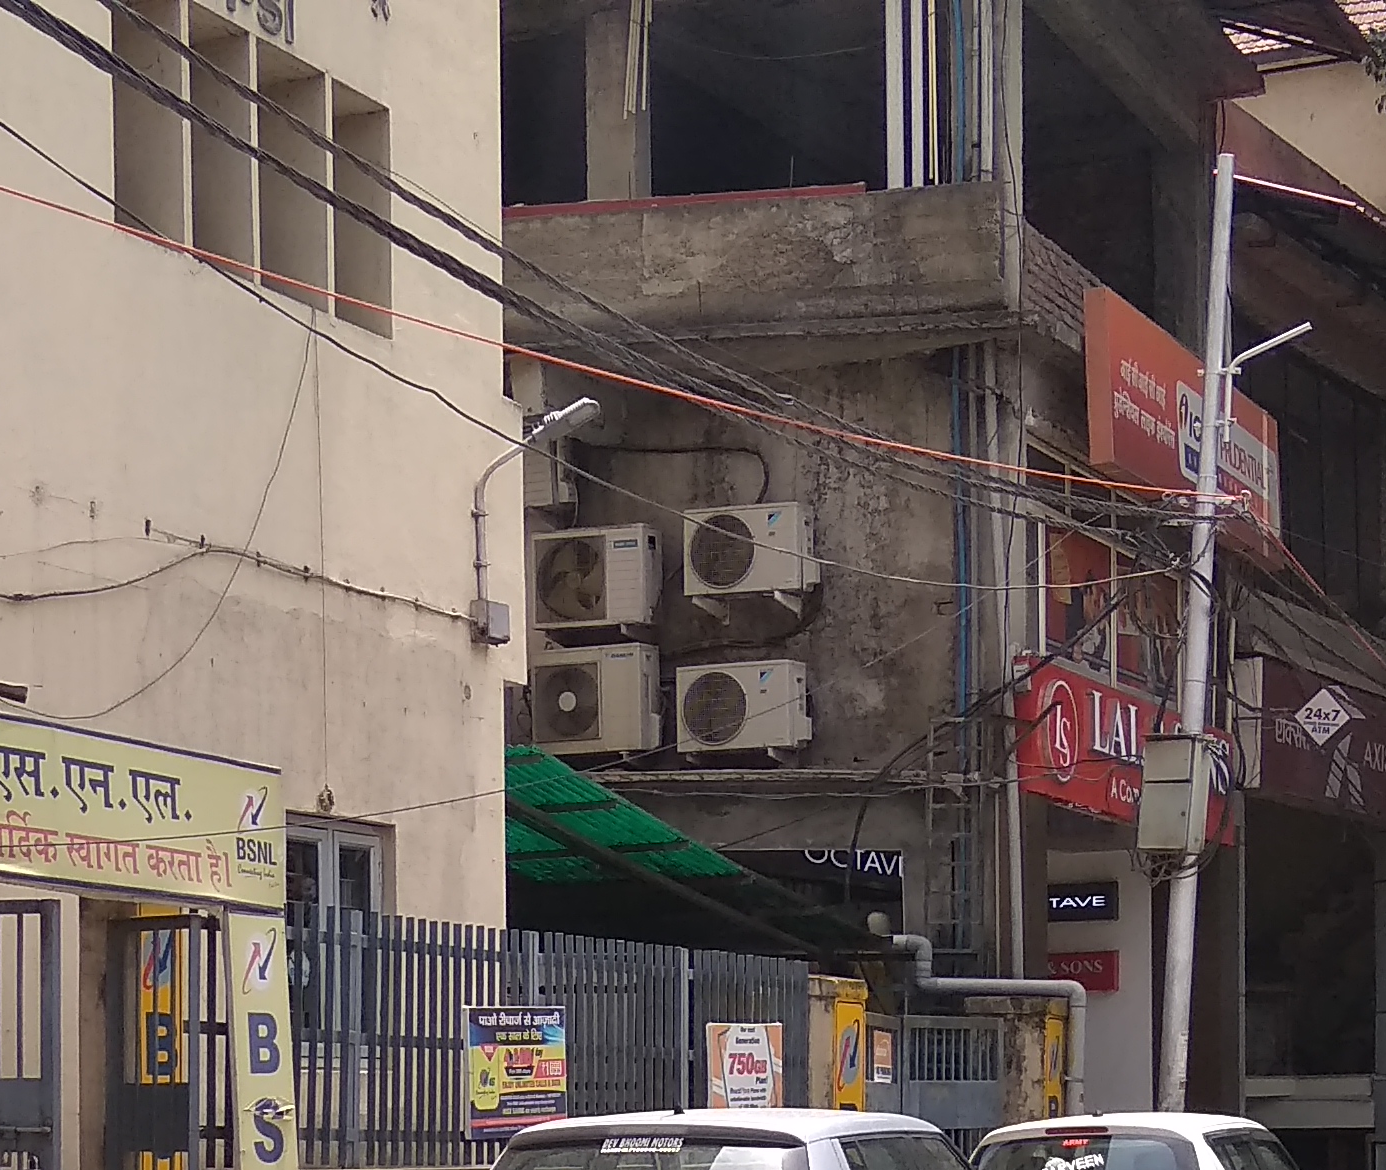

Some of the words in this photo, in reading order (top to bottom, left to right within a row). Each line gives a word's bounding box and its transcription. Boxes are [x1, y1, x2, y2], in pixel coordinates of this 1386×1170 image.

[1304, 707, 1341, 722] 24x7
[236, 836, 278, 867] BSNL
[145, 844, 204, 883] करता
[1049, 894, 1106, 910] TAVE
[651, 1137, 685, 1148] MOTORS
